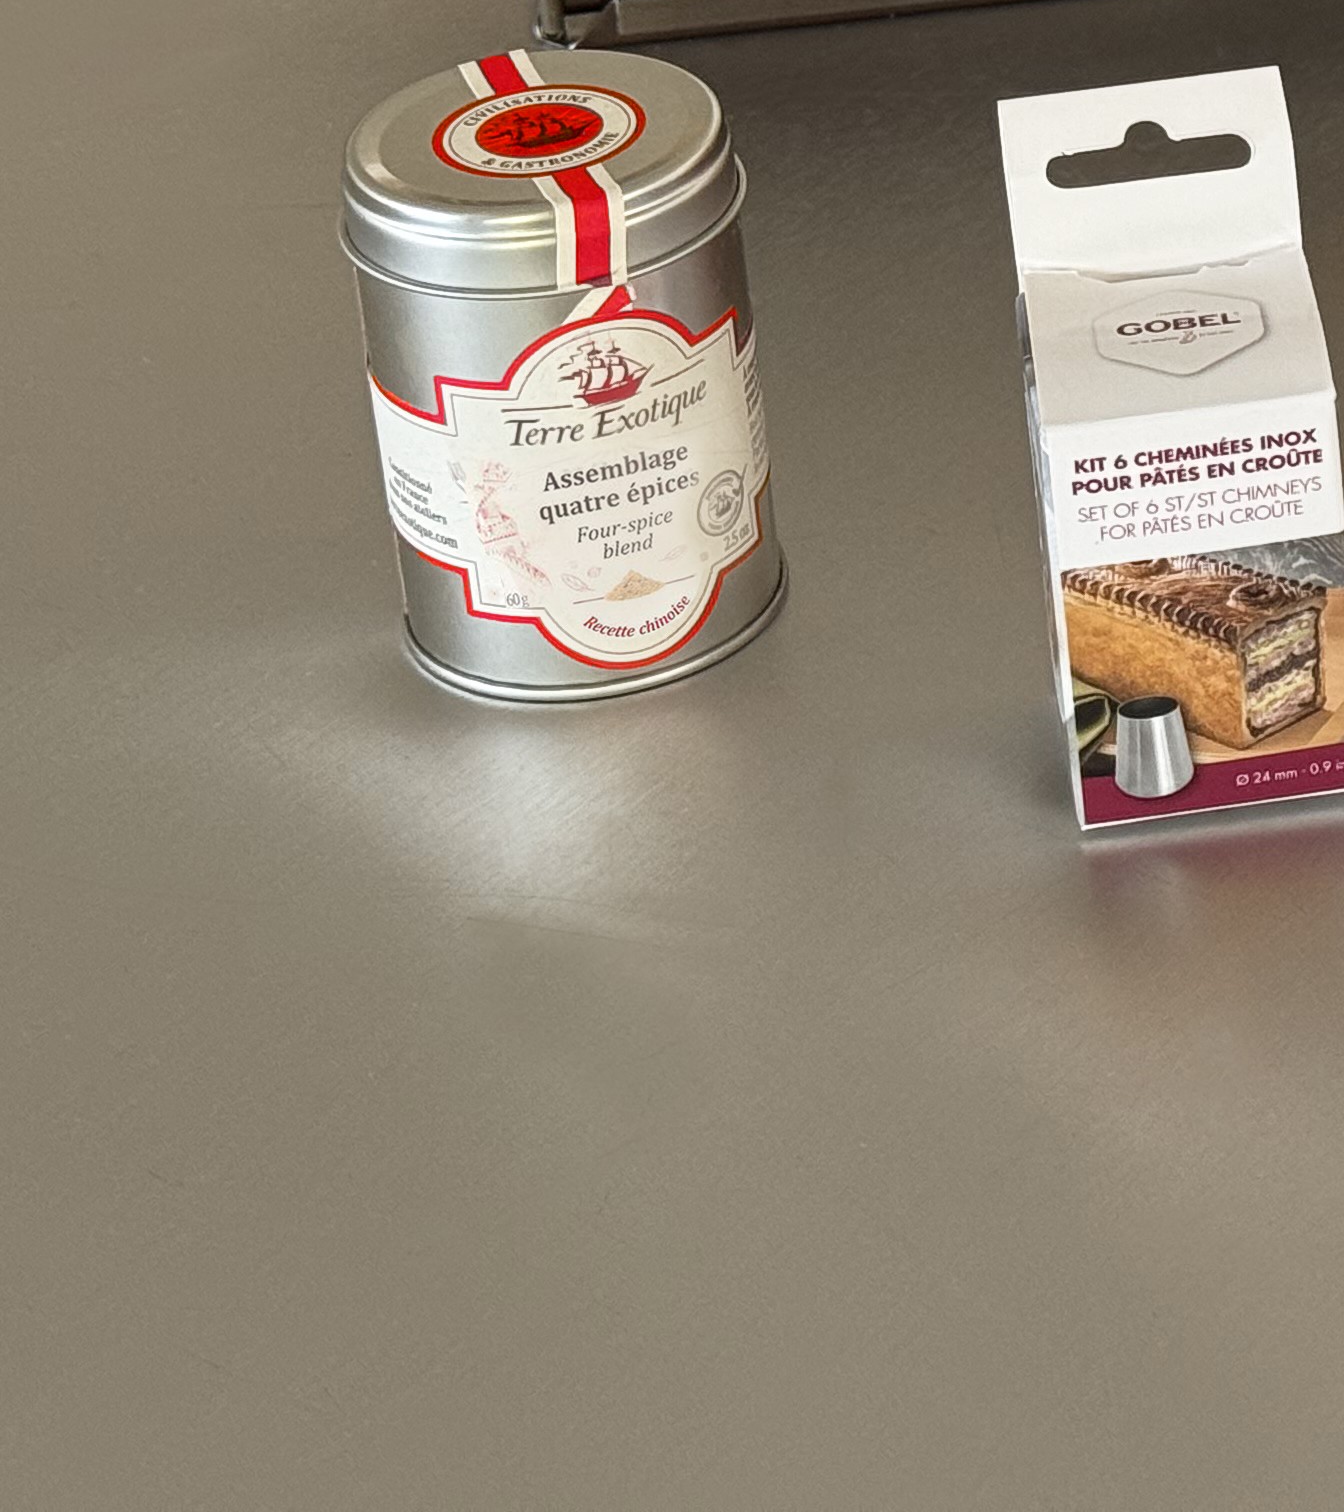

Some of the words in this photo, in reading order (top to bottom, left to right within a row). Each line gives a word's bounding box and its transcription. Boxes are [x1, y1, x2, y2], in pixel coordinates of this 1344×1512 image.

[463, 93, 592, 127] CIVILISATIONS
[499, 130, 620, 171] GASTRONOMIE
[1116, 312, 1242, 337] GOBEL
[504, 418, 585, 447] Terre
[592, 378, 708, 440] Exotique
[543, 445, 689, 492] Assemblage
[1072, 475, 1133, 496] POUR
[1140, 464, 1200, 488] PÂTÉS
[1207, 461, 1236, 479] EN
[1242, 448, 1323, 474] CROÛTE
[1074, 456, 1107, 475] KIT
[1114, 454, 1128, 470] 6
[1134, 437, 1254, 467] CHEMINÉES
[1260, 428, 1317, 451] INOX
[539, 492, 621, 525] quatre
[626, 470, 701, 506] épices
[1078, 504, 1108, 523] SET
[1113, 501, 1140, 519] OF
[1145, 499, 1159, 515] 6
[1165, 491, 1217, 512] ST/ST
[1222, 476, 1322, 504] CHIMNEYS
[576, 508, 674, 544] Four-spice
[1100, 523, 1137, 542] FOR
[1142, 515, 1192, 537] PÂTÉS
[1198, 510, 1225, 529] EN
[1229, 499, 1305, 524] CROÛTE
[602, 532, 655, 560] blend
[583, 615, 636, 638] Recette
[638, 595, 691, 636] chinoise
[1253, 770, 1271, 784] 24
[1274, 769, 1299, 781] mm
[1309, 760, 1332, 776] 0.9
